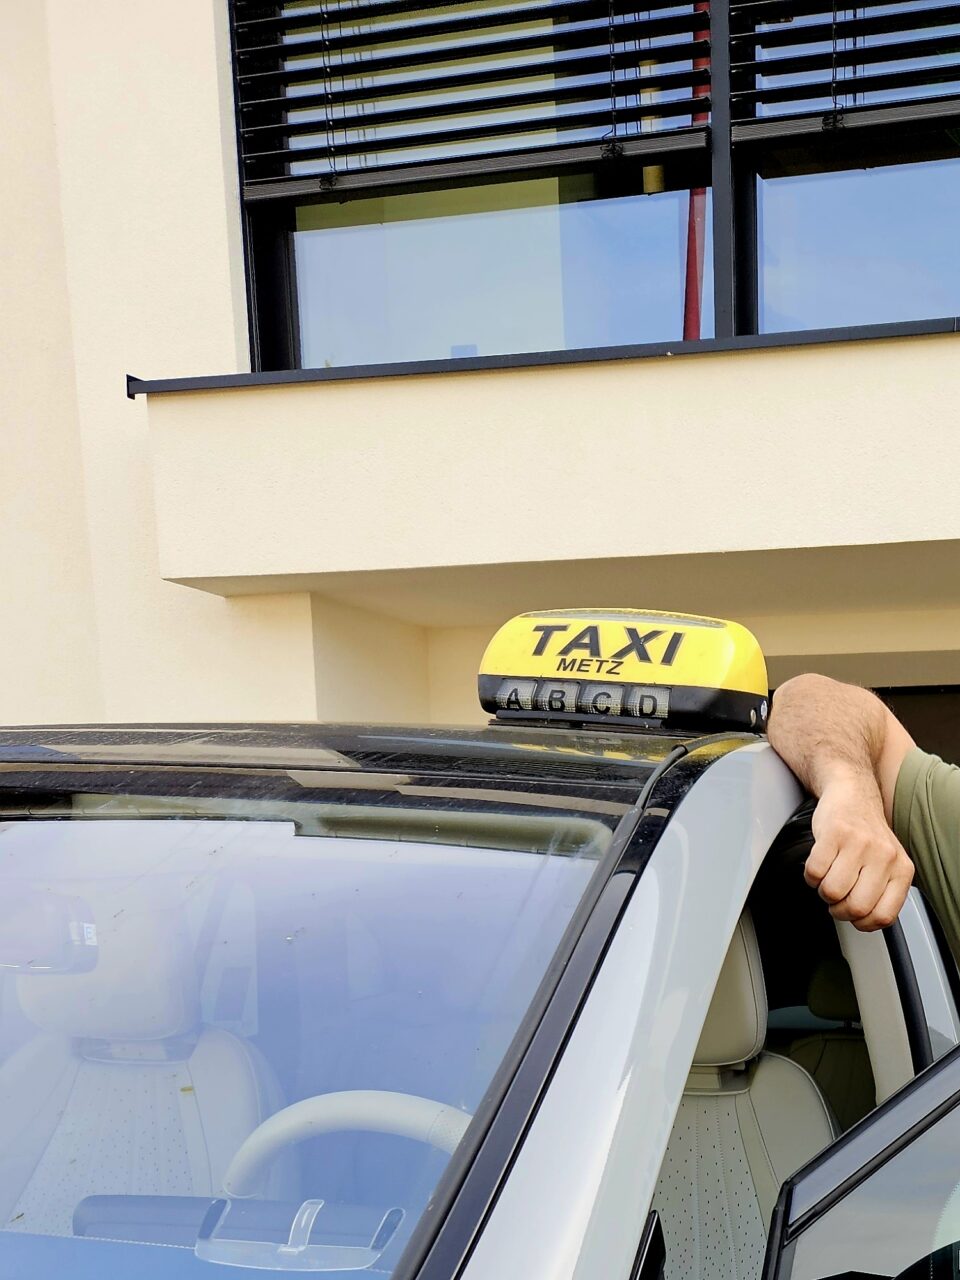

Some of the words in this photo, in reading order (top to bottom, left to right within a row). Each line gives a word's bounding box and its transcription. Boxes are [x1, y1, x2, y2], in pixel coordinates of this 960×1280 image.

[531, 623, 686, 667] TAXI
[556, 657, 624, 676] METZ
[506, 687, 523, 711] A
[547, 689, 567, 711] B
[591, 691, 613, 715] C
[638, 694, 658, 717] D
